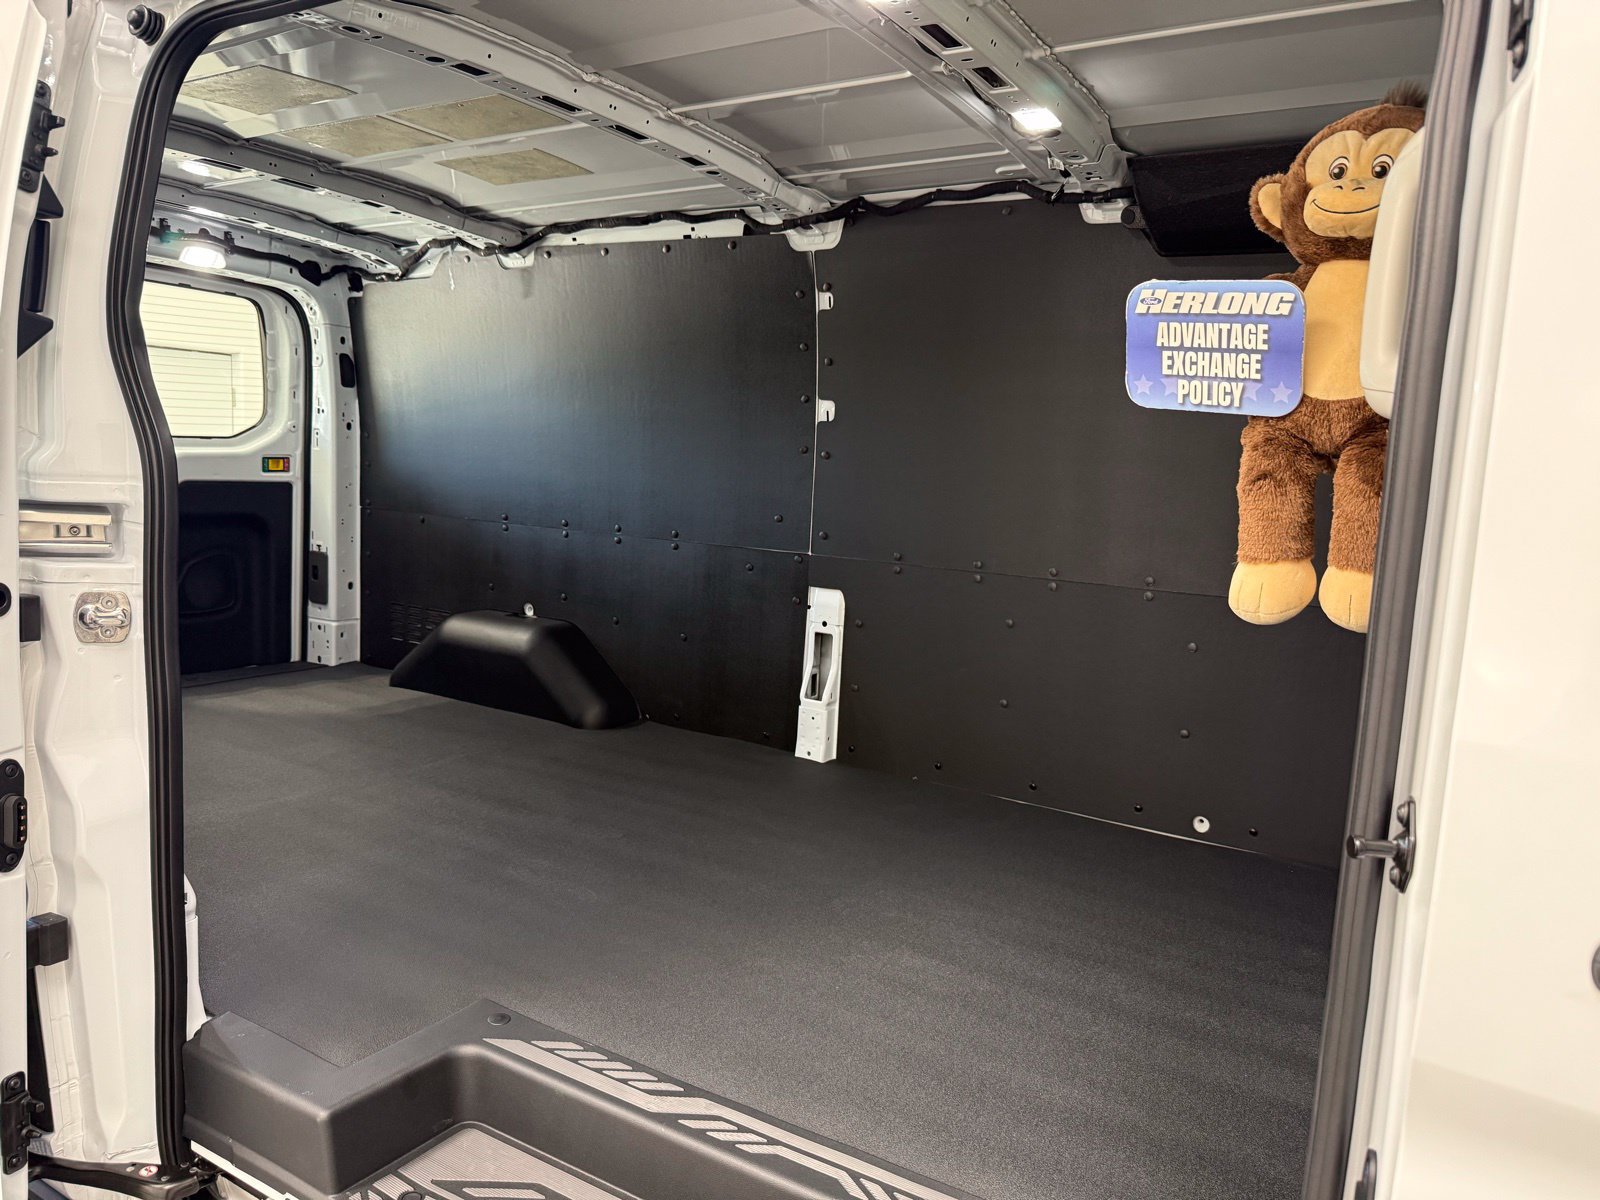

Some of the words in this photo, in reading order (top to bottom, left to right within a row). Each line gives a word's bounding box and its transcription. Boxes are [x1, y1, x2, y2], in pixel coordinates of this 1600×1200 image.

[1135, 289, 1295, 315] HERLONG
[1156, 322, 1268, 350] ADVANTAGE
[1162, 351, 1261, 379] EXCHANGE
[1178, 380, 1244, 407] POLICY
